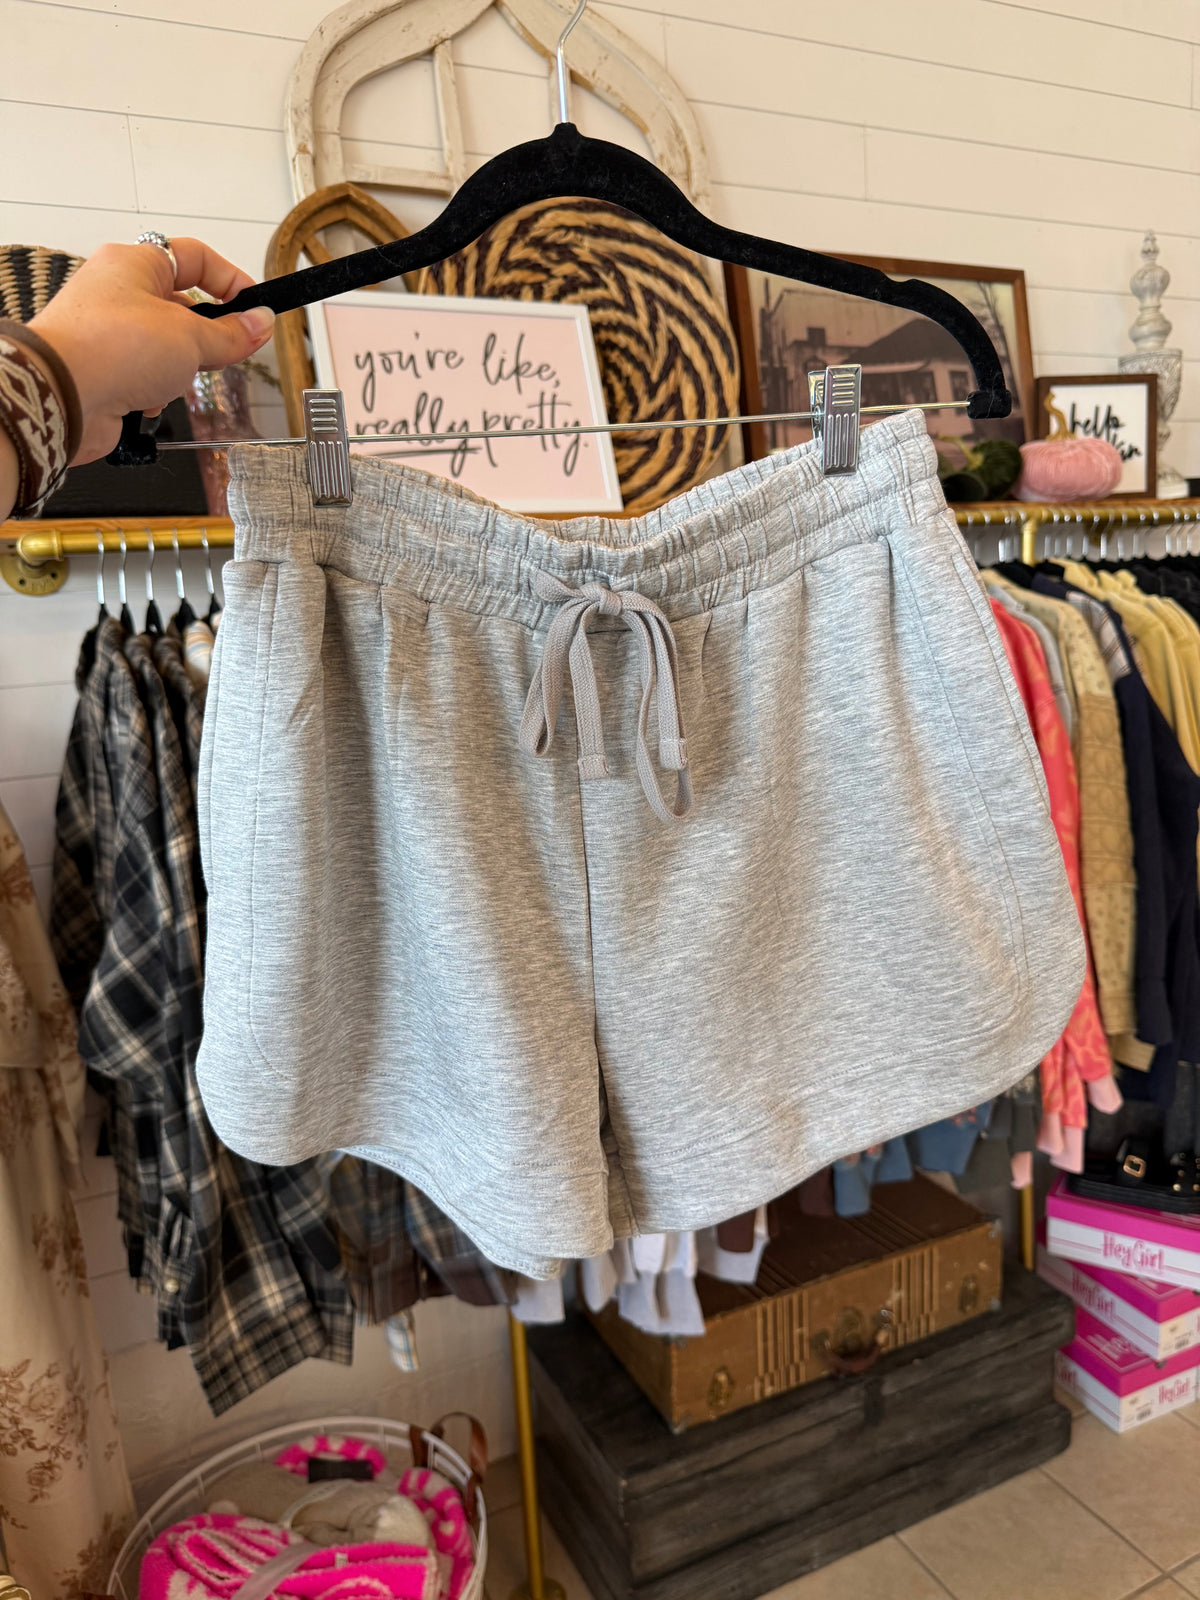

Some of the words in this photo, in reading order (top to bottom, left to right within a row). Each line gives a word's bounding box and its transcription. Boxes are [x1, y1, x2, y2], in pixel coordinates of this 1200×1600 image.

[355, 331, 464, 413] you're
[482, 332, 561, 395] like,
[355, 391, 471, 478] really
[482, 391, 589, 477] pretty.
[1069, 402, 1125, 443] hello
